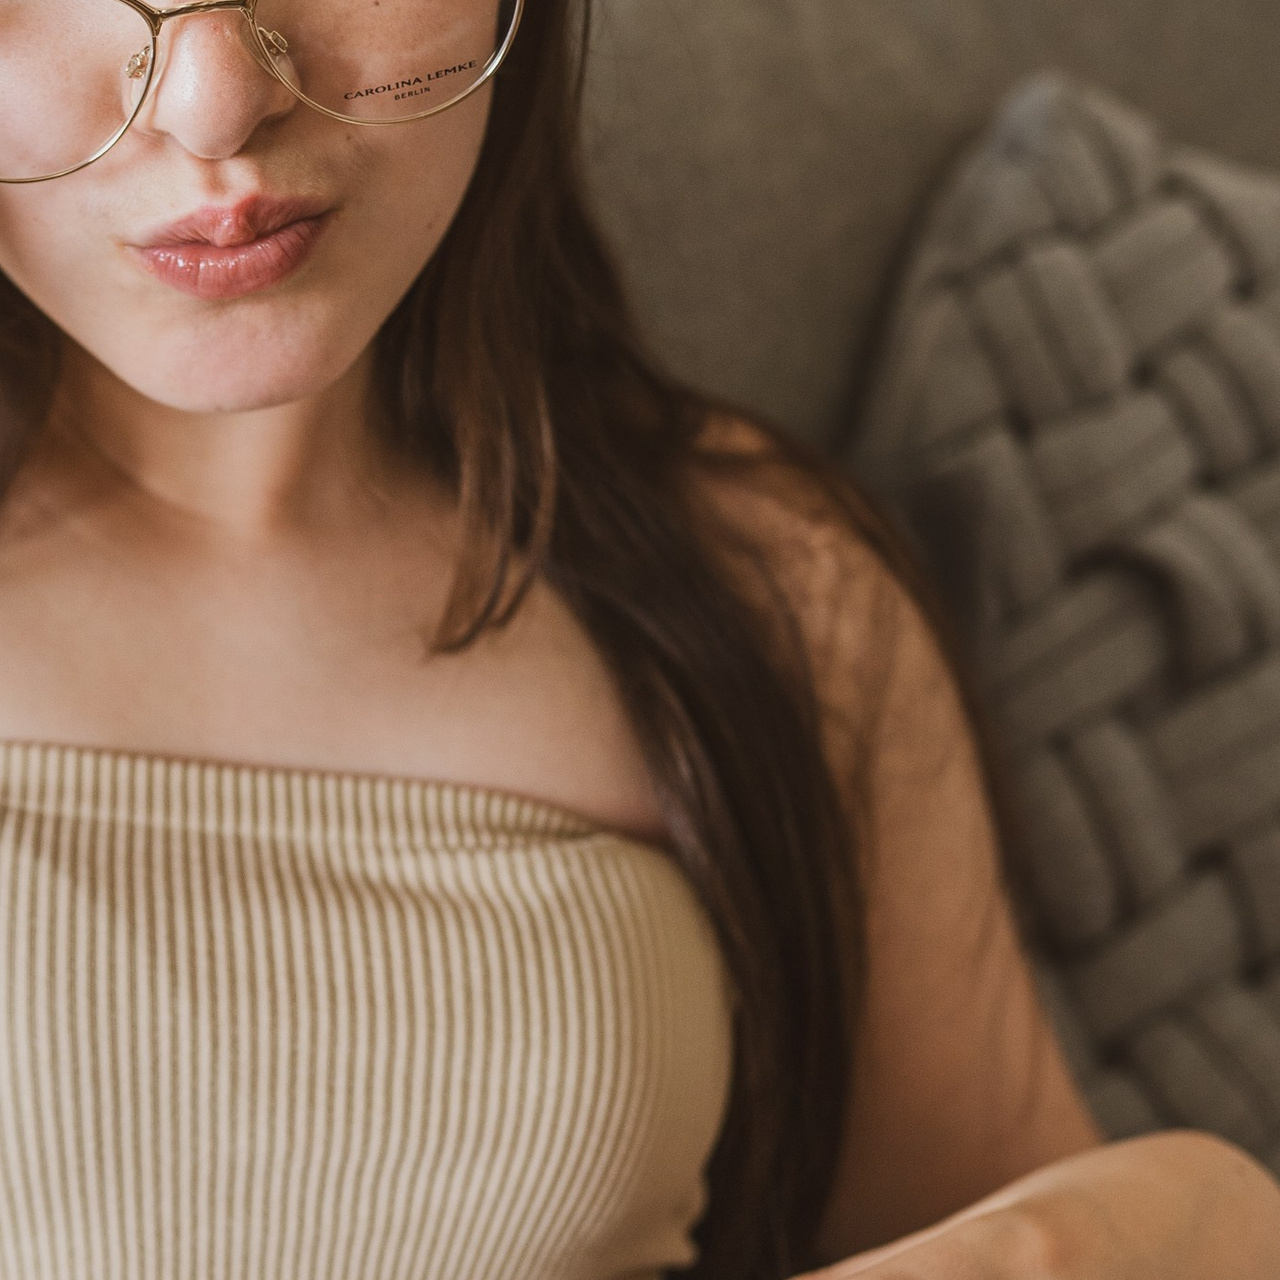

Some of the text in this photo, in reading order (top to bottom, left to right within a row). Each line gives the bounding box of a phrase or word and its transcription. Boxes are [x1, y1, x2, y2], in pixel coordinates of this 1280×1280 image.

[344, 60, 478, 100] CAROLINA LEMKE
[394, 86, 431, 101] BERLIN
